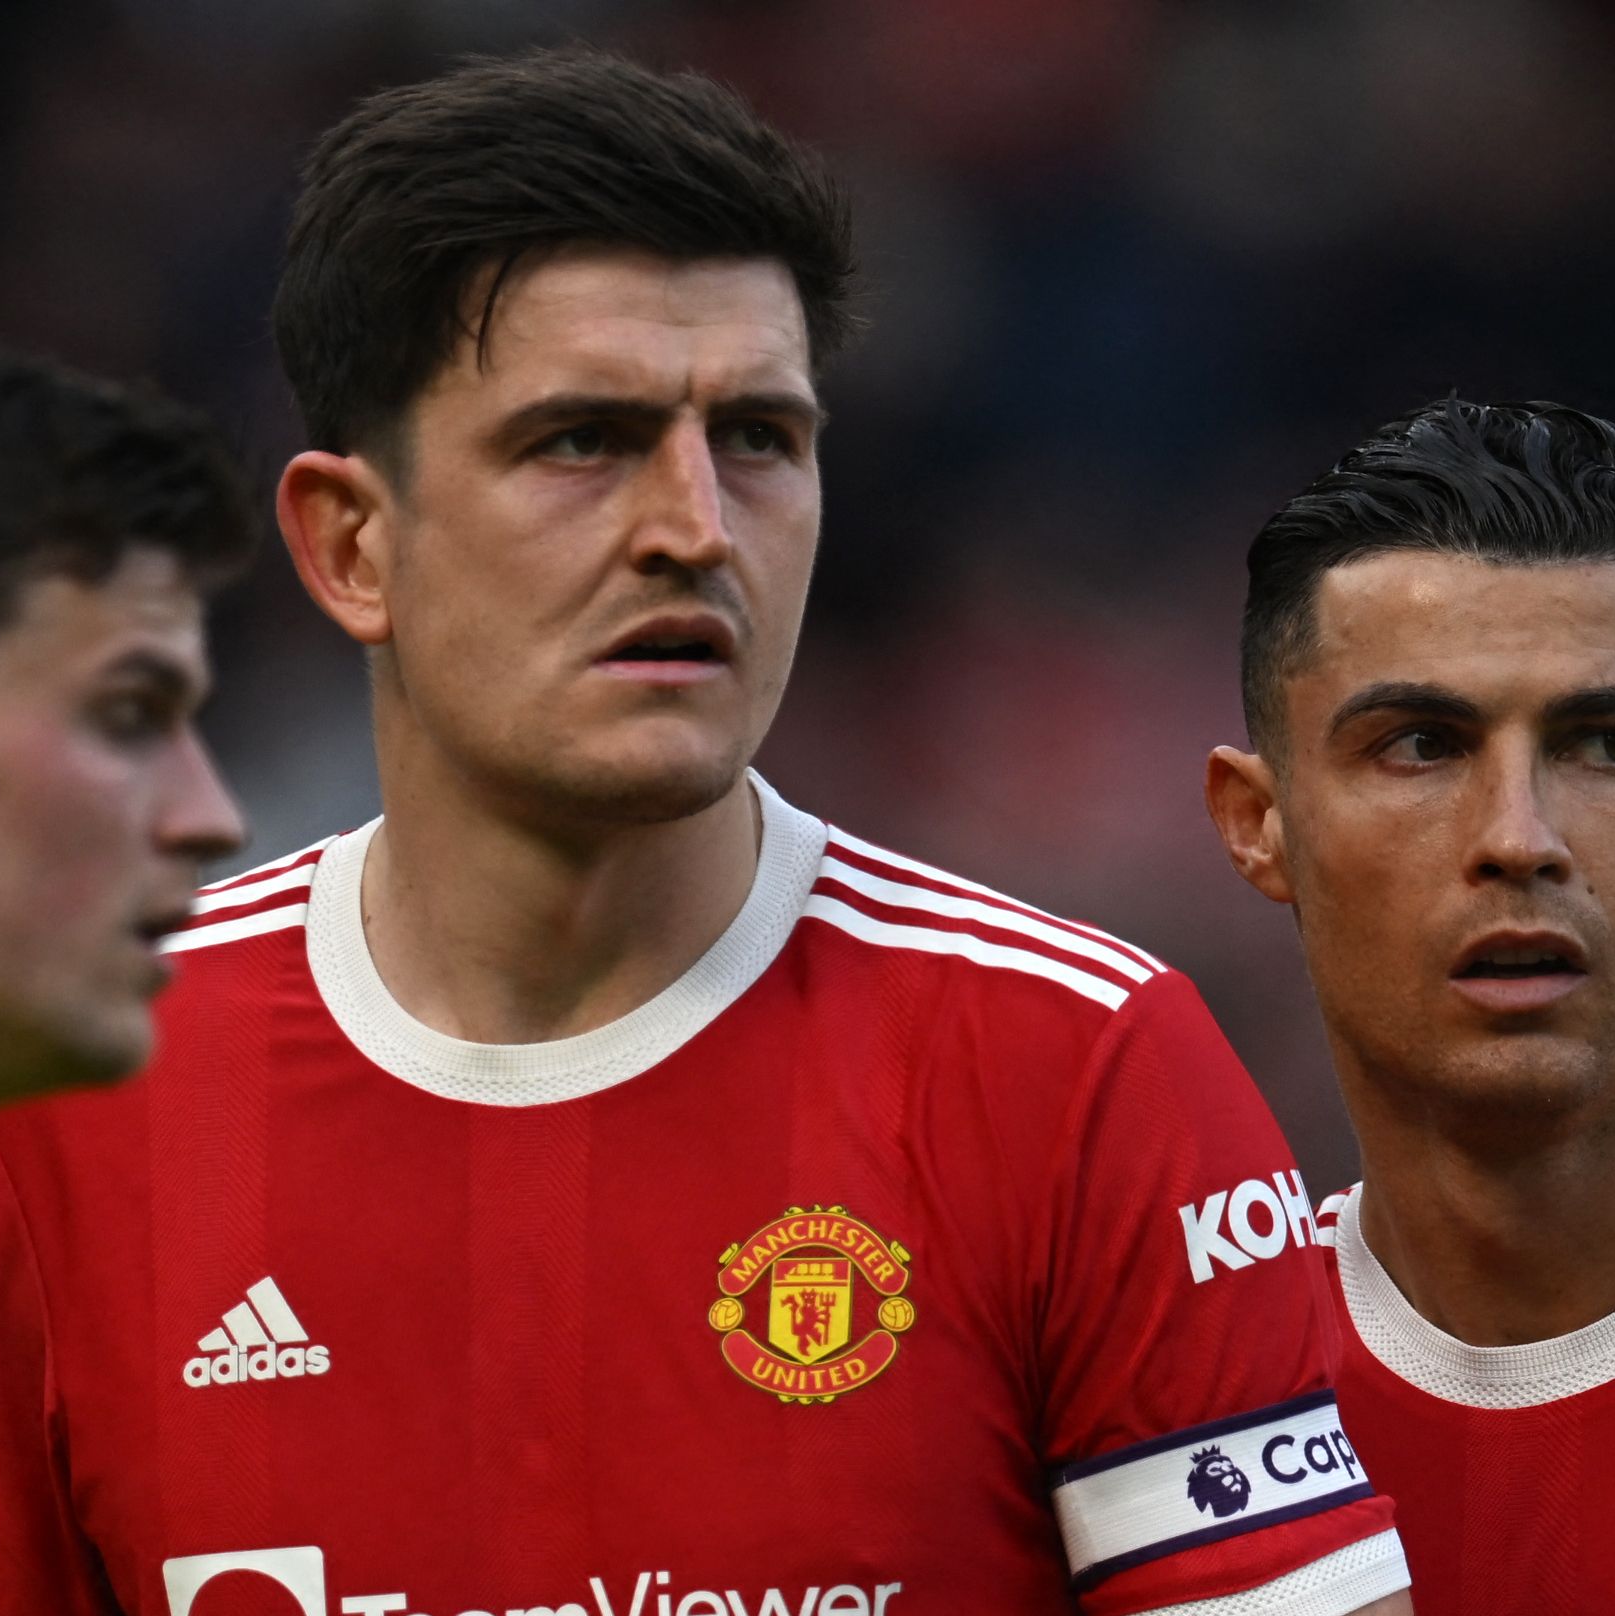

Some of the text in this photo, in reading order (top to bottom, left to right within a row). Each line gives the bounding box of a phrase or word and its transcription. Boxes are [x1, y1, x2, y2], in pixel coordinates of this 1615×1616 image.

[731, 1220, 895, 1283] MANCHESTER
[183, 1342, 331, 1388] adidas
[752, 1356, 866, 1390] UNITED
[1261, 1429, 1356, 1484] Cap
